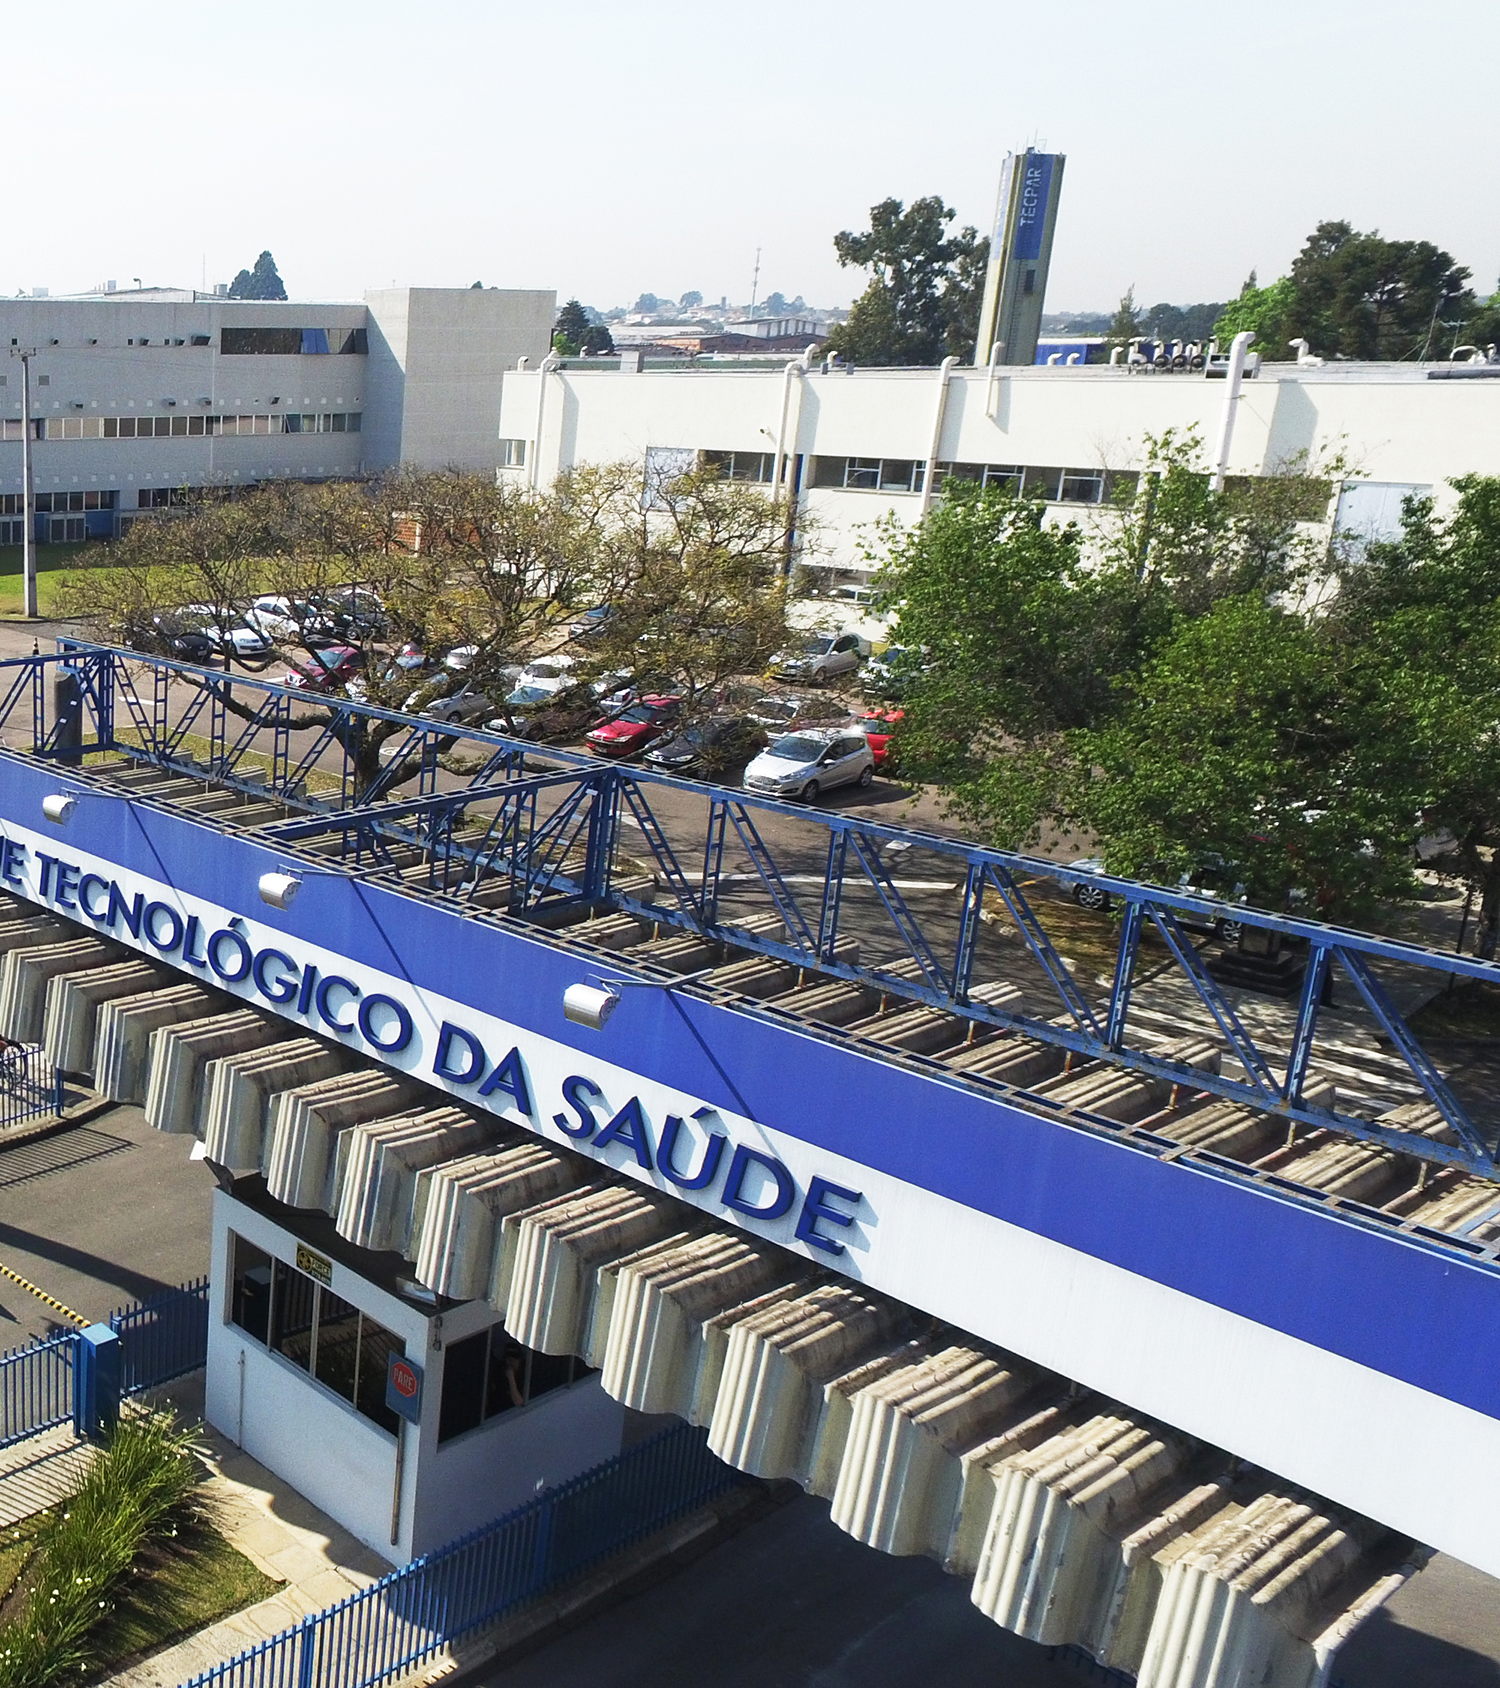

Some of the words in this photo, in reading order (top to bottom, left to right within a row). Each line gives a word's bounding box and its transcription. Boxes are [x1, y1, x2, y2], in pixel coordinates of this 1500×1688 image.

[1020, 168, 1042, 227] TECPAR
[35, 850, 412, 1053] TECNOLÓGICO
[432, 1019, 533, 1116] DA
[552, 1075, 863, 1256] SAÚDE
[393, 1367, 414, 1392] PARE
